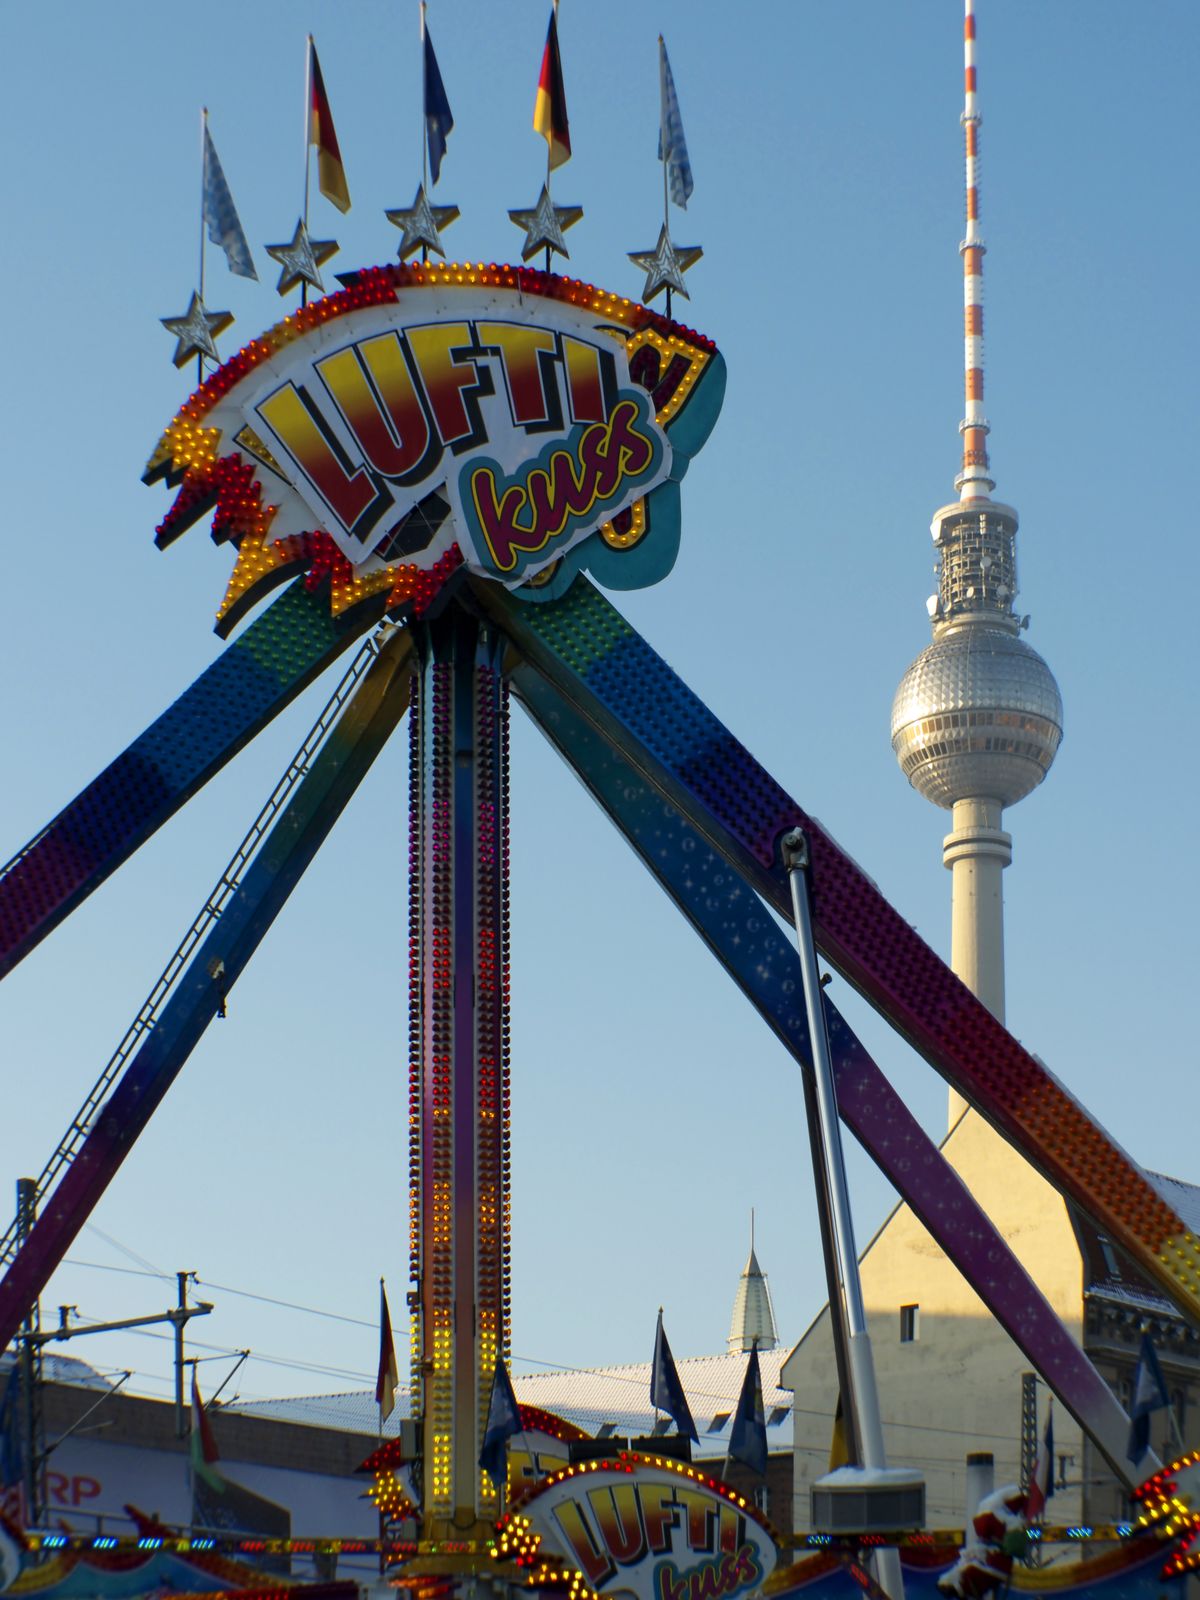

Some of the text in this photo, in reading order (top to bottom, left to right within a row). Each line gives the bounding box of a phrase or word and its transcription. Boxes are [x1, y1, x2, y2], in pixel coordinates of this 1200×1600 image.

[251, 319, 613, 541] LUFTI
[470, 400, 654, 572] kuss
[552, 1481, 742, 1588] LUFTI
